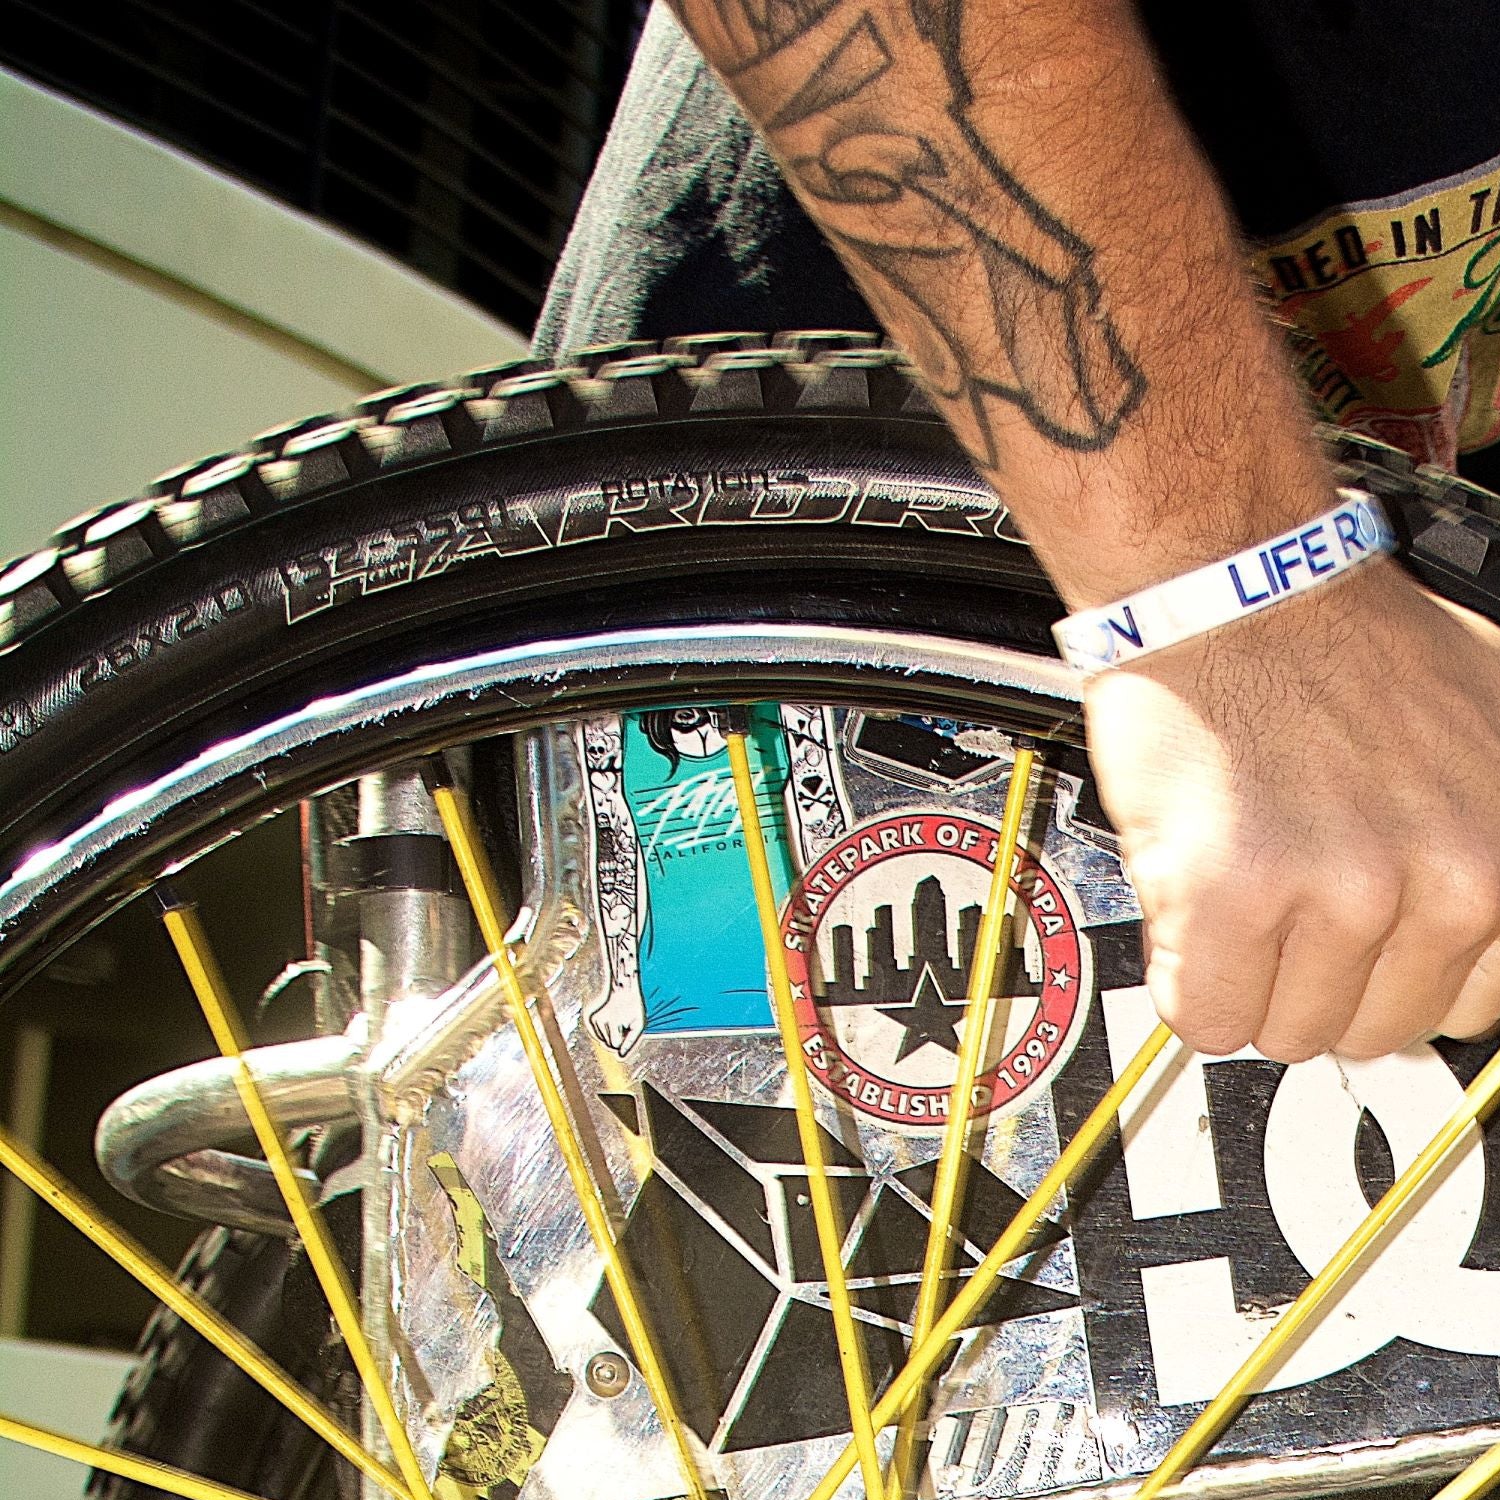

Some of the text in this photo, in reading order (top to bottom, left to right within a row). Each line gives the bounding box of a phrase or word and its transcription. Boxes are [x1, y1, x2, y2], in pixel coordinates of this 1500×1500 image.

[1391, 208, 1443, 257] IN
[1228, 525, 1335, 608] LIFE
[784, 823, 926, 952] SKATEPARK
[936, 823, 979, 851] OF
[802, 1021, 1060, 1117] ESTABLISHD 1993
